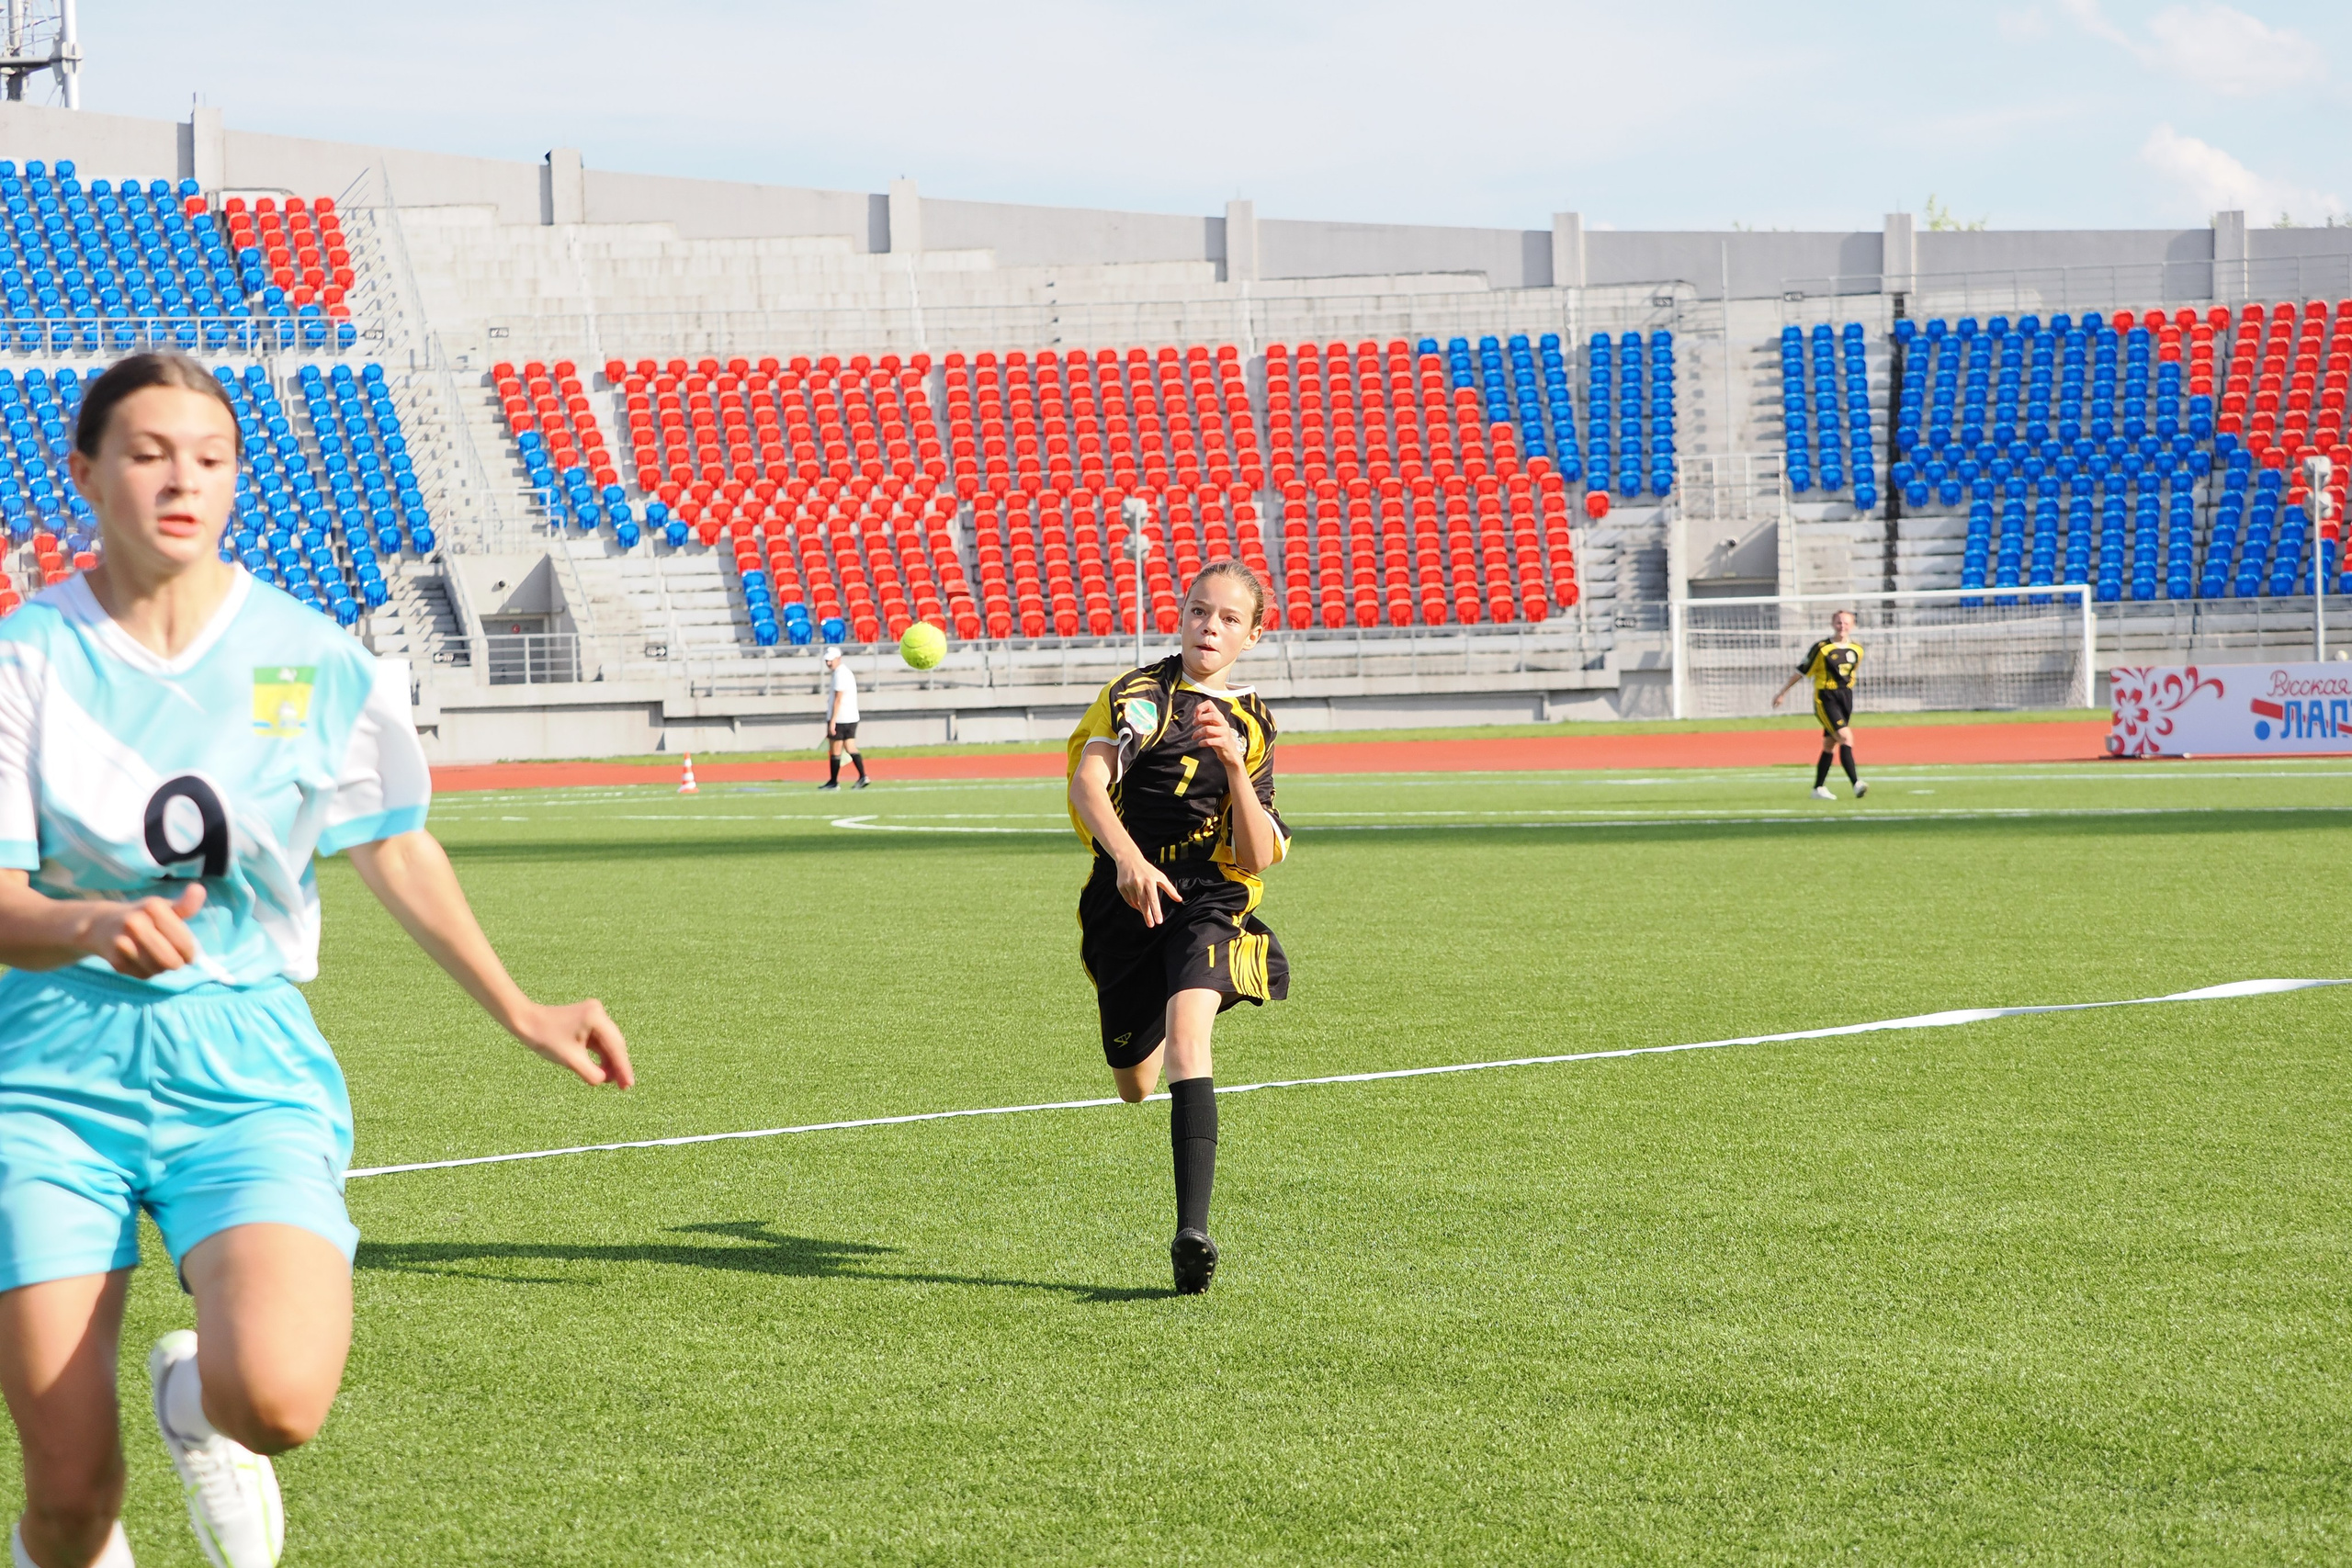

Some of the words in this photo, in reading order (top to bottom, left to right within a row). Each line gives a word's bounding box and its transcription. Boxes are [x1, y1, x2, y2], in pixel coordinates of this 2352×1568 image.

[2267, 670, 2352, 696] Русская
[2280, 699, 2352, 739] ЛАП
[144, 775, 229, 880] 9
[1207, 943, 1216, 968] 1
